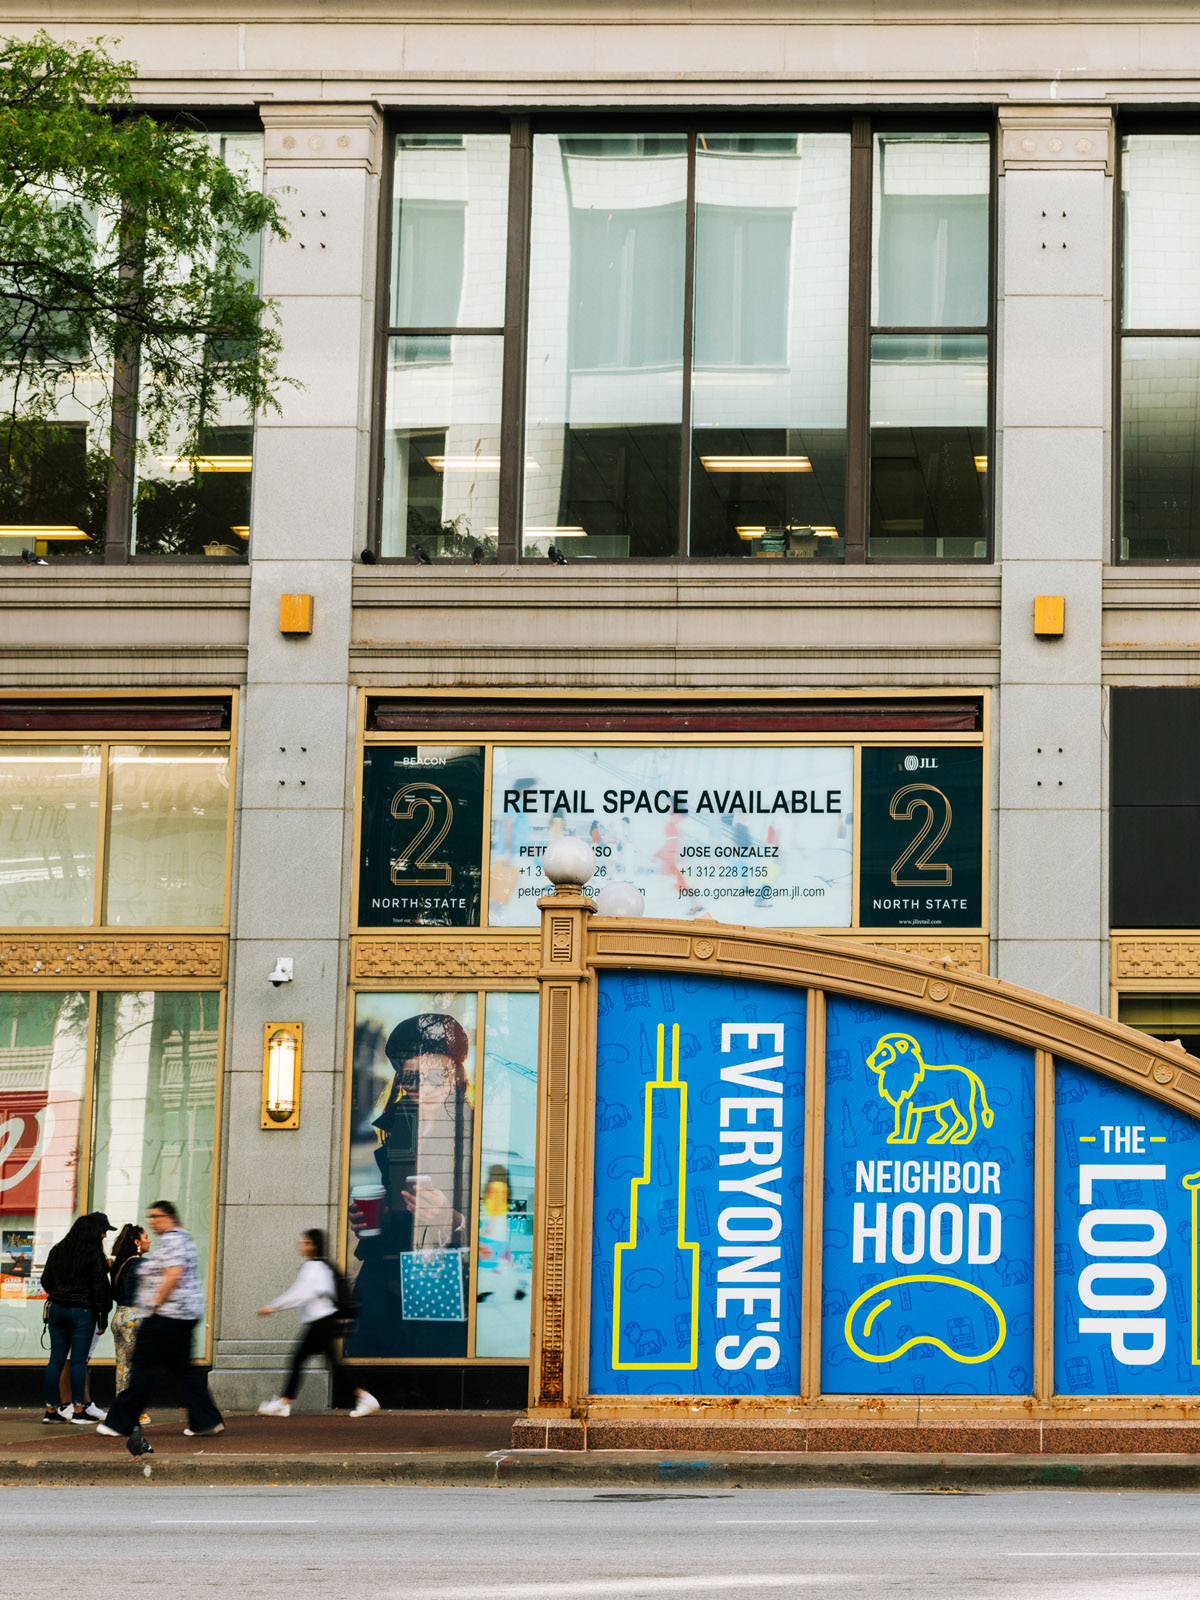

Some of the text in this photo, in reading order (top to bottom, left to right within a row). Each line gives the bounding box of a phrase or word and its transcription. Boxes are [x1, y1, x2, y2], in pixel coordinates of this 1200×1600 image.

[403, 757, 447, 766] BEACON
[918, 757, 939, 769] JLL
[503, 789, 842, 814] RETAIL SPACE AVAILABLE
[390, 781, 454, 886] 2
[889, 782, 953, 887] 2
[679, 846, 779, 858] JOSE GONZALEZ
[519, 866, 531, 877] +1
[679, 865, 768, 878] +1 312 228 2155
[678, 885, 825, 900] jose.o.gonzalez@am.jll.com
[371, 898, 467, 909] NORTH STATE
[873, 899, 968, 910] NORTH STATE
[1100, 1125, 1146, 1154] THE
[855, 1160, 1001, 1194] NEIGHBOR
[715, 1022, 785, 1371] EVERYONE'S
[852, 1202, 1002, 1265] HOOD
[1078, 1164, 1167, 1366] LOOP
